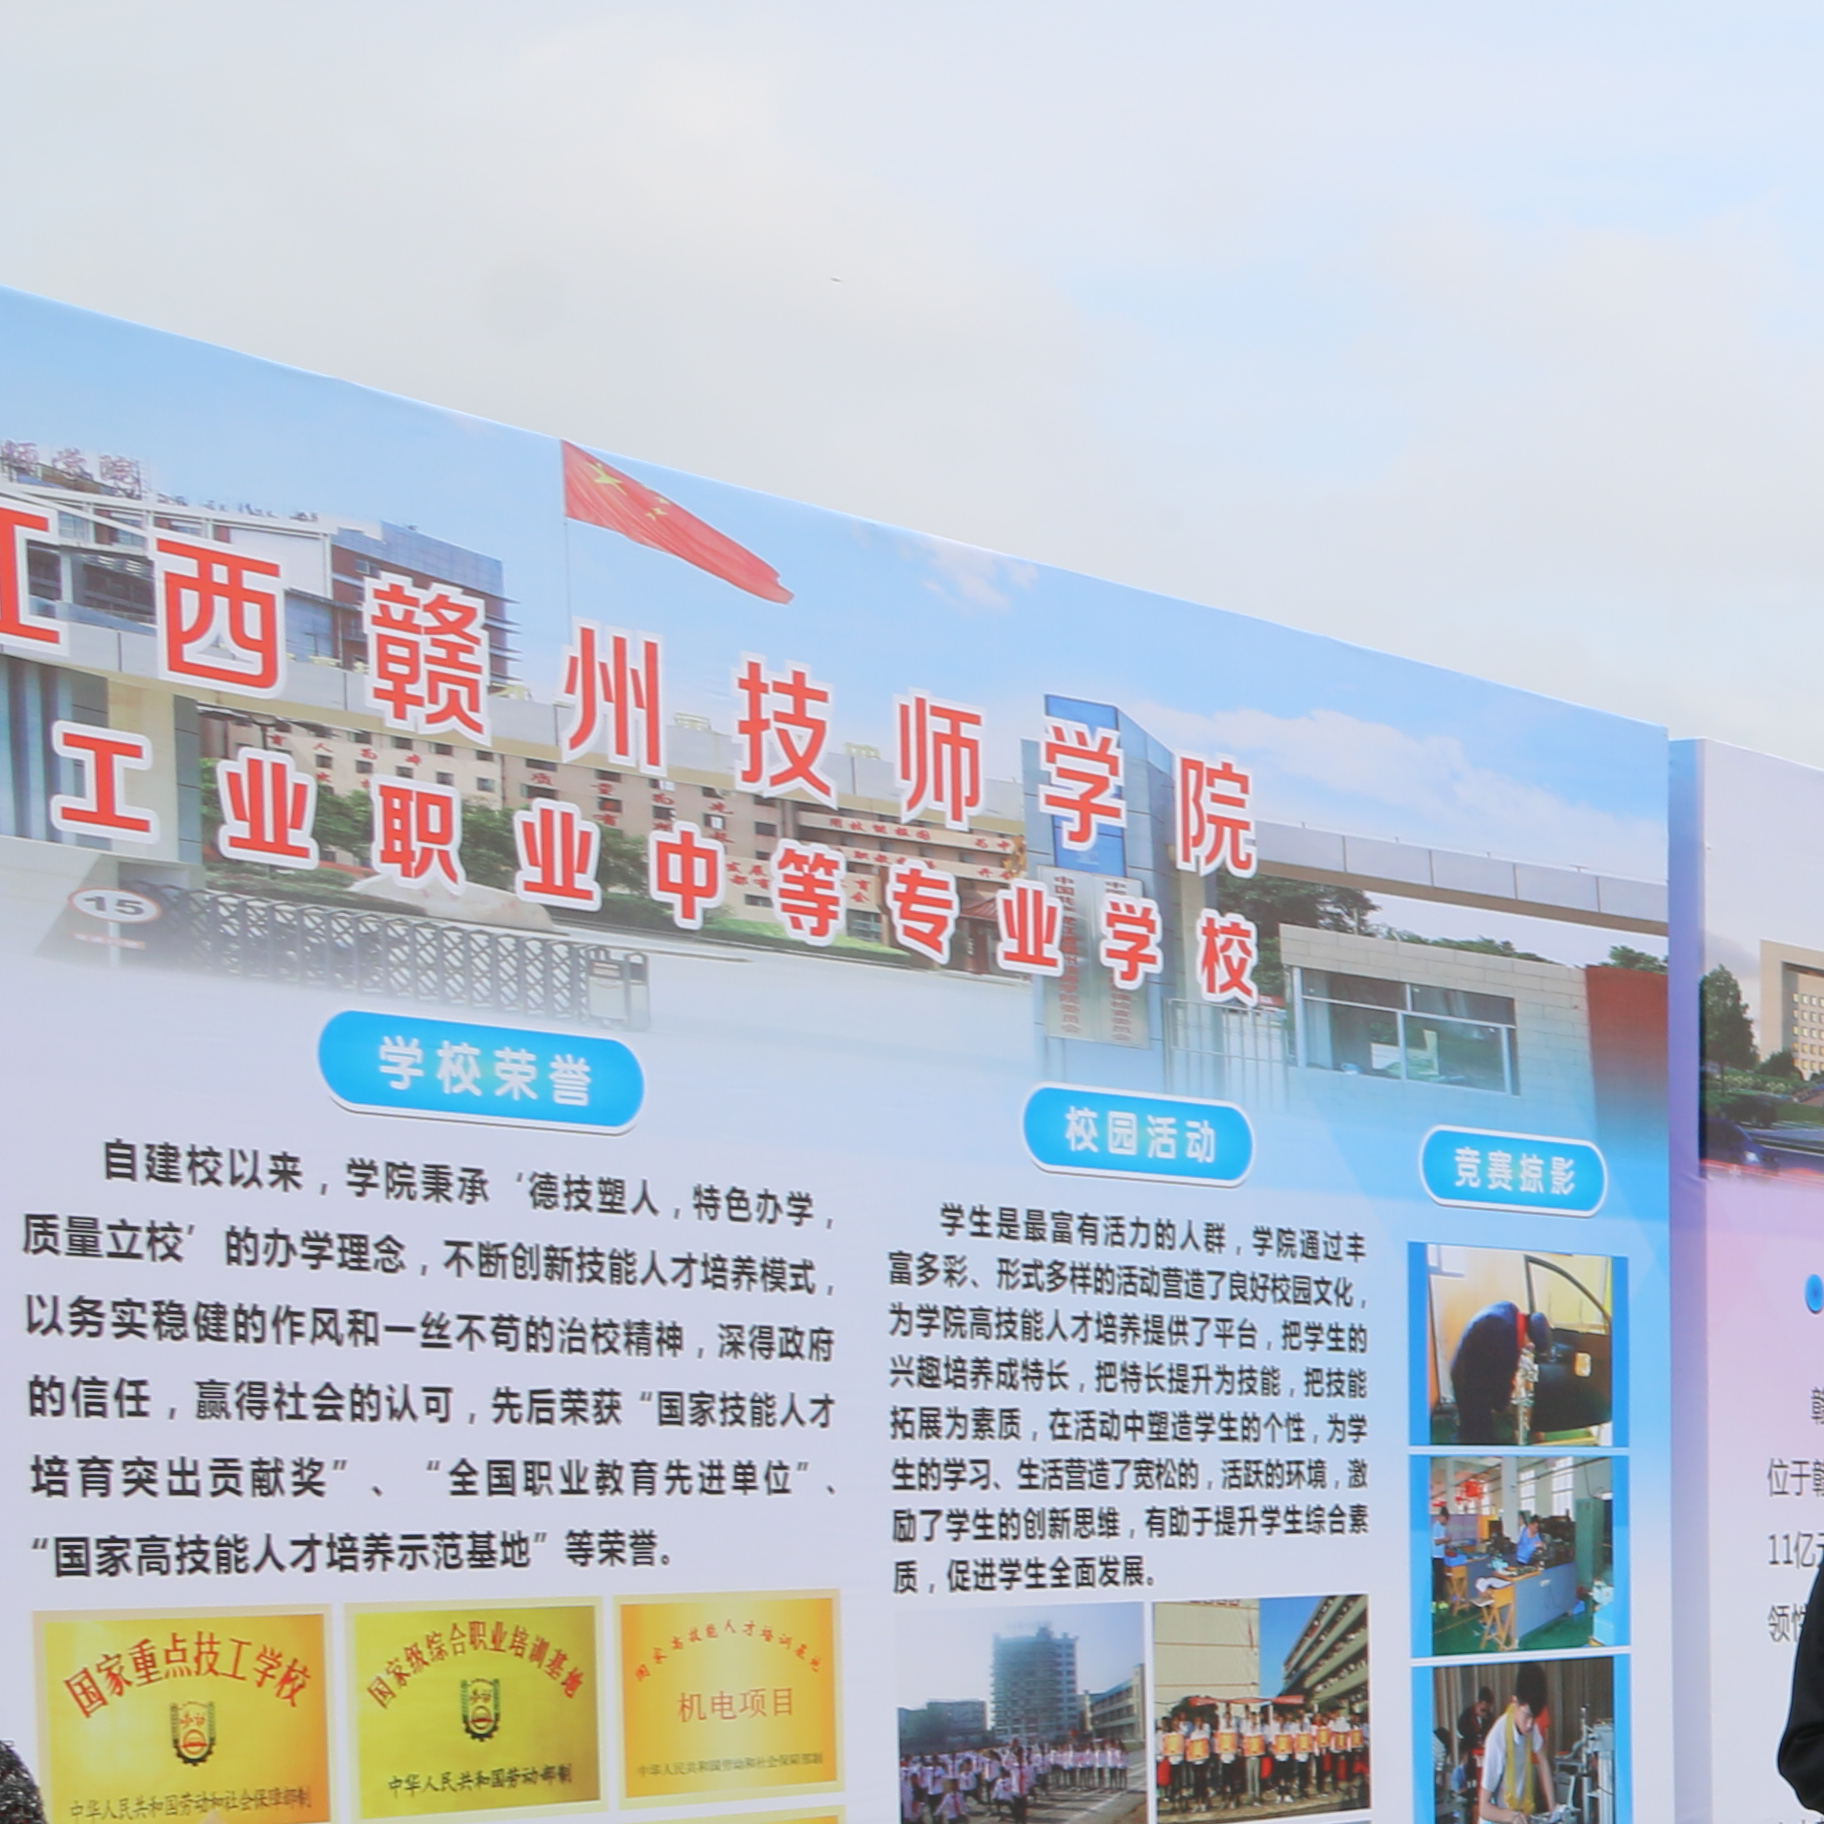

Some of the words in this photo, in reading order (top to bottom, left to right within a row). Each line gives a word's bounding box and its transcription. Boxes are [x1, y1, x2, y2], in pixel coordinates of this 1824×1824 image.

[60, 730, 1255, 1002] 工业职业中等专业学校
[83, 895, 145, 915] 15
[378, 1036, 593, 1108] 学校荣誉
[1065, 1106, 1217, 1164] 校园活动
[1454, 1146, 1576, 1197] 竞赛掠影
[939, 1201, 1367, 1263] 学生是最富有活力的人群，学院通过丰
[888, 1251, 1367, 1310] 富多彩、形式多样的活动营造了良好校园文化，
[24, 1295, 837, 1363] 以务实稳健的作风和一丝不苟的治校精神，深得政府
[888, 1303, 1368, 1354] 为学院高技能人才培养提供了平台，把学生的
[889, 1354, 1368, 1400] 兴趣培养成特长，把特长提升为技能，把技能
[889, 1405, 1368, 1445] 拓展为素质，在活动中塑造学生的个性，为学
[891, 1457, 1369, 1493] 生的学习、生活营造了宽松的，活跃的环境，激
[892, 1503, 1370, 1543] 励了学生的创新思维，有助于提升学生综合素
[893, 1554, 1156, 1594] 质，促进学生全面发展。
[63, 1630, 312, 1718] 国家重点技工学校
[366, 1620, 585, 1709] 国家级综合职业培训基地
[677, 1687, 794, 1723] 机电项目
